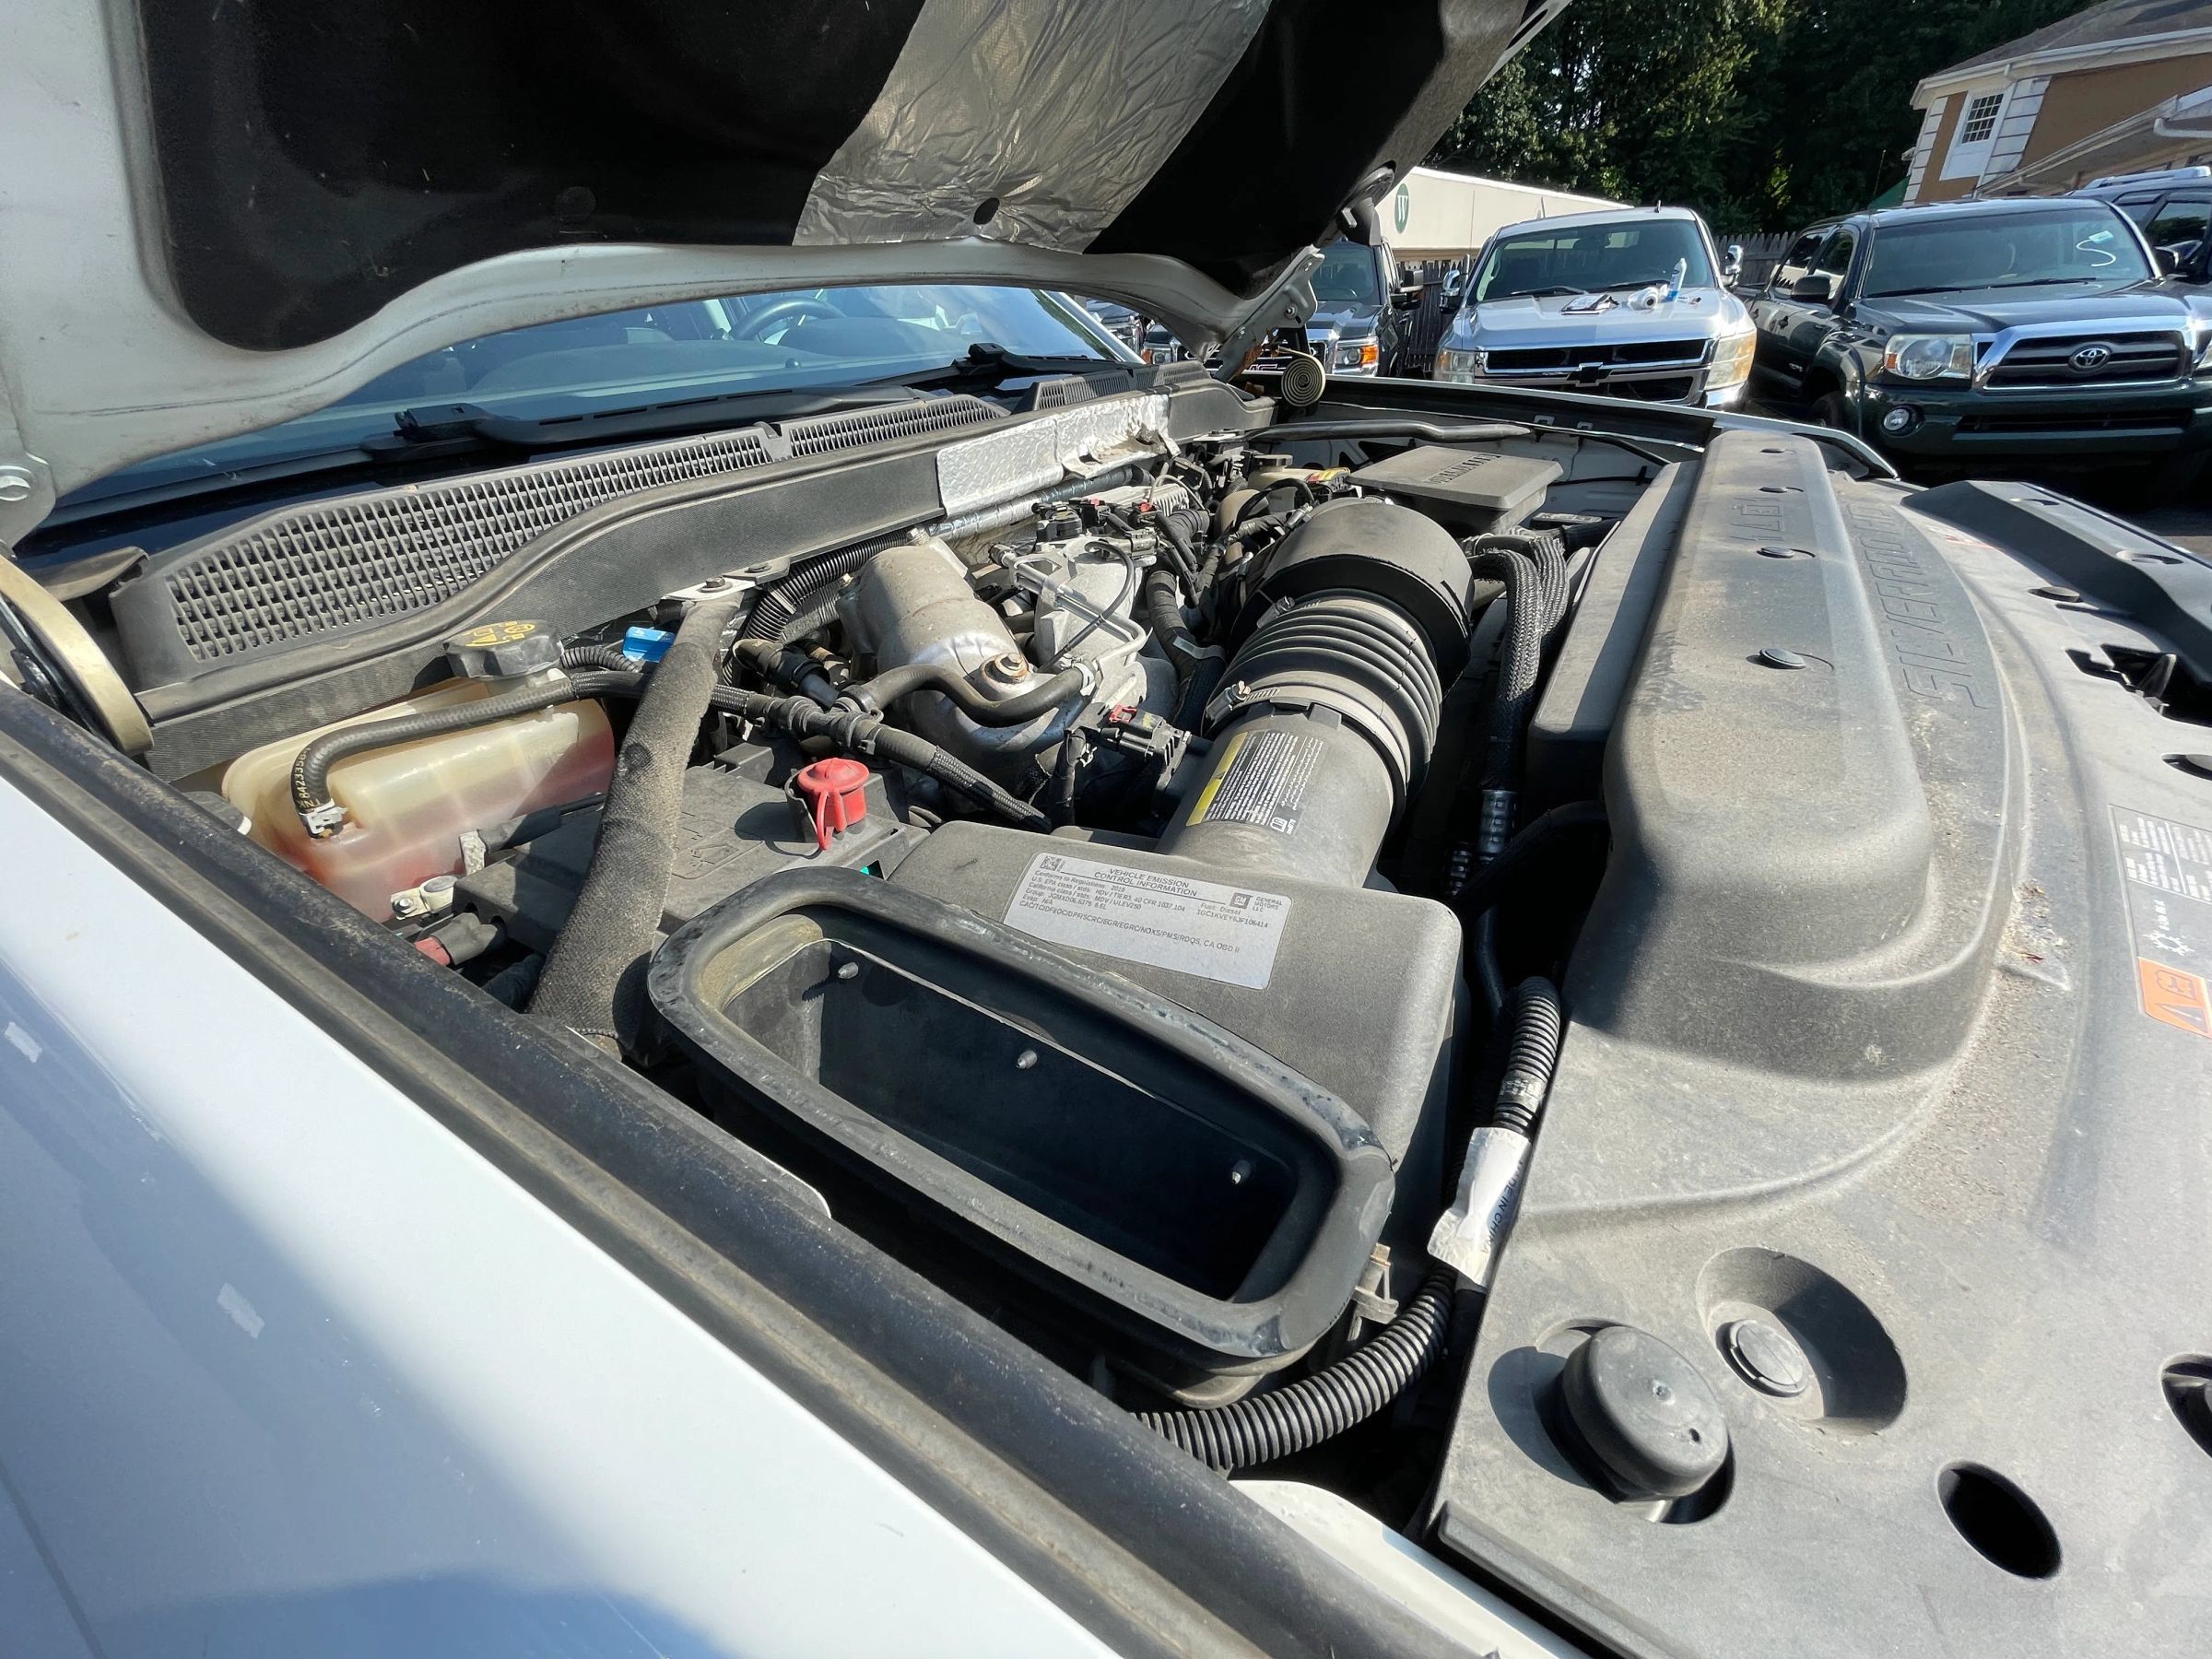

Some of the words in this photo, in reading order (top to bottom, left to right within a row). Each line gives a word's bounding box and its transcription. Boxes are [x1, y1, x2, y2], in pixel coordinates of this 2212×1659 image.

[1396, 194, 1408, 222] W
[1034, 870, 1063, 880] Conforms
[1110, 868, 1146, 880] VEHICLE
[1147, 875, 1190, 888] EMISSION
[1094, 871, 1135, 885] CONTROL
[1136, 880, 1197, 897] INFORMATION
[1094, 895, 1109, 903] MDV
[1113, 898, 1142, 910] ULEV250
[1095, 888, 1110, 897] HDV
[1143, 898, 1157, 906] CFR
[1256, 896, 1283, 906] GENERAL
[1219, 906, 1241, 915] Diesel
[1253, 901, 1278, 910] MOTORS
[1204, 939, 1215, 948] CA
[1216, 942, 1234, 951] OBD
[1498, 1195, 1509, 1212] IN
